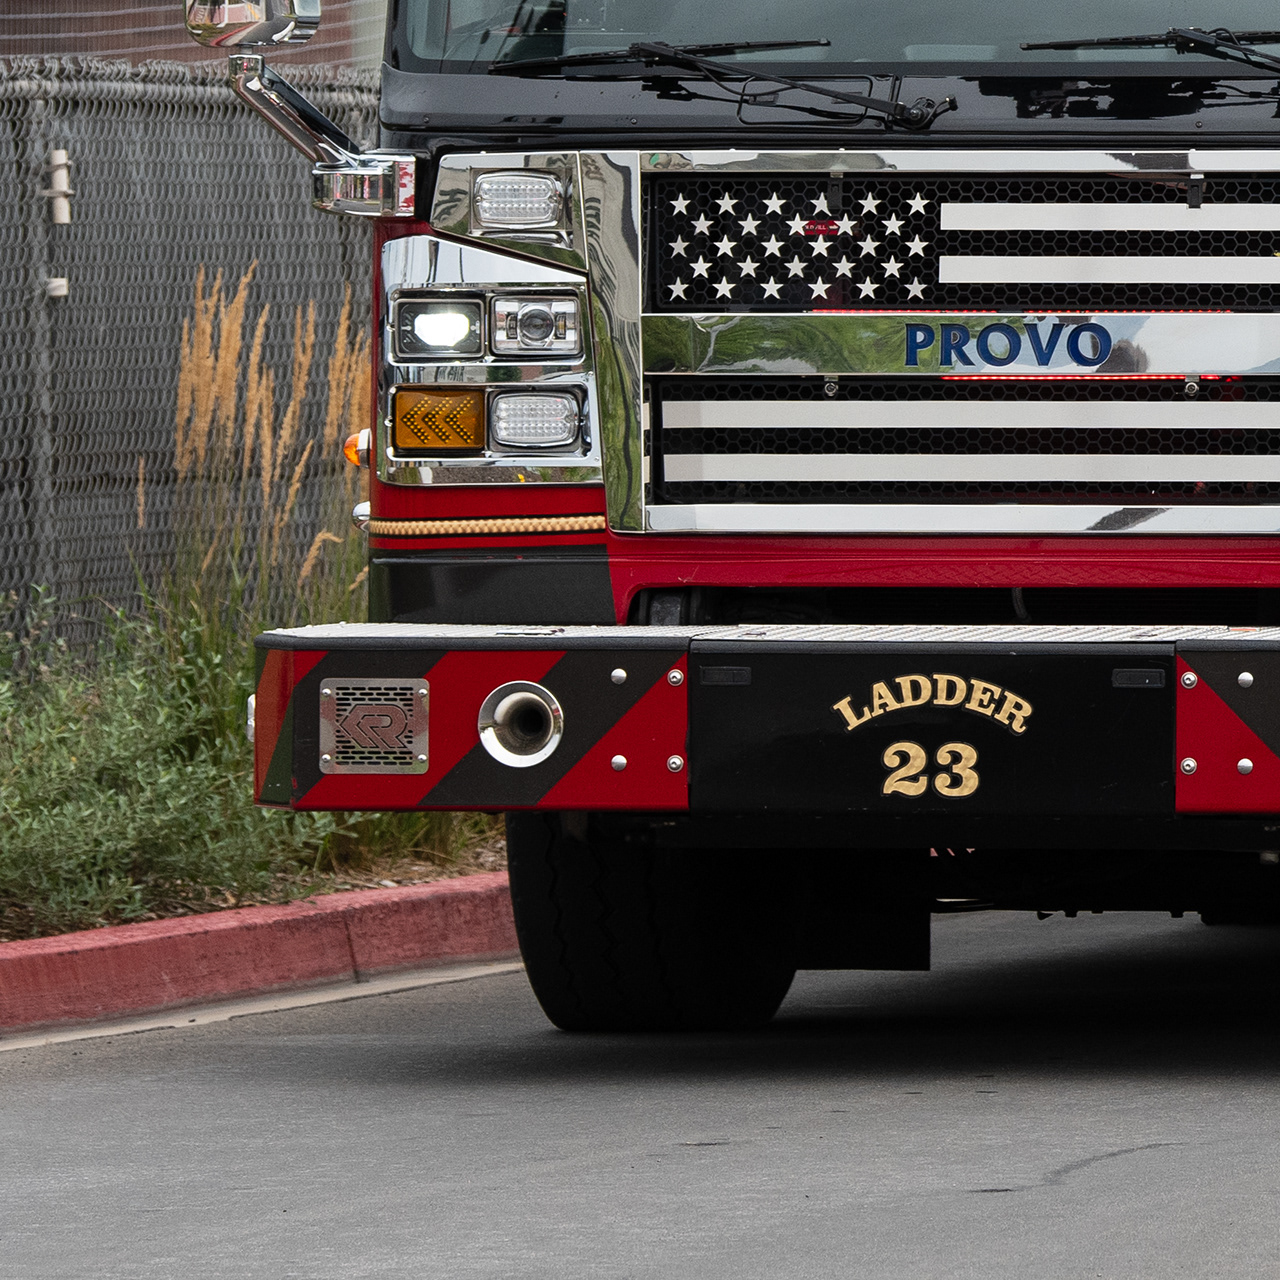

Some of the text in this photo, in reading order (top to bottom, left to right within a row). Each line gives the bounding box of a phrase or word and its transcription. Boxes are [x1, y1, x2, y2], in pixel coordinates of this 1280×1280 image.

[904, 322, 1113, 367] PROVO
[833, 675, 1031, 732] LADDER
[884, 743, 978, 796] 23
